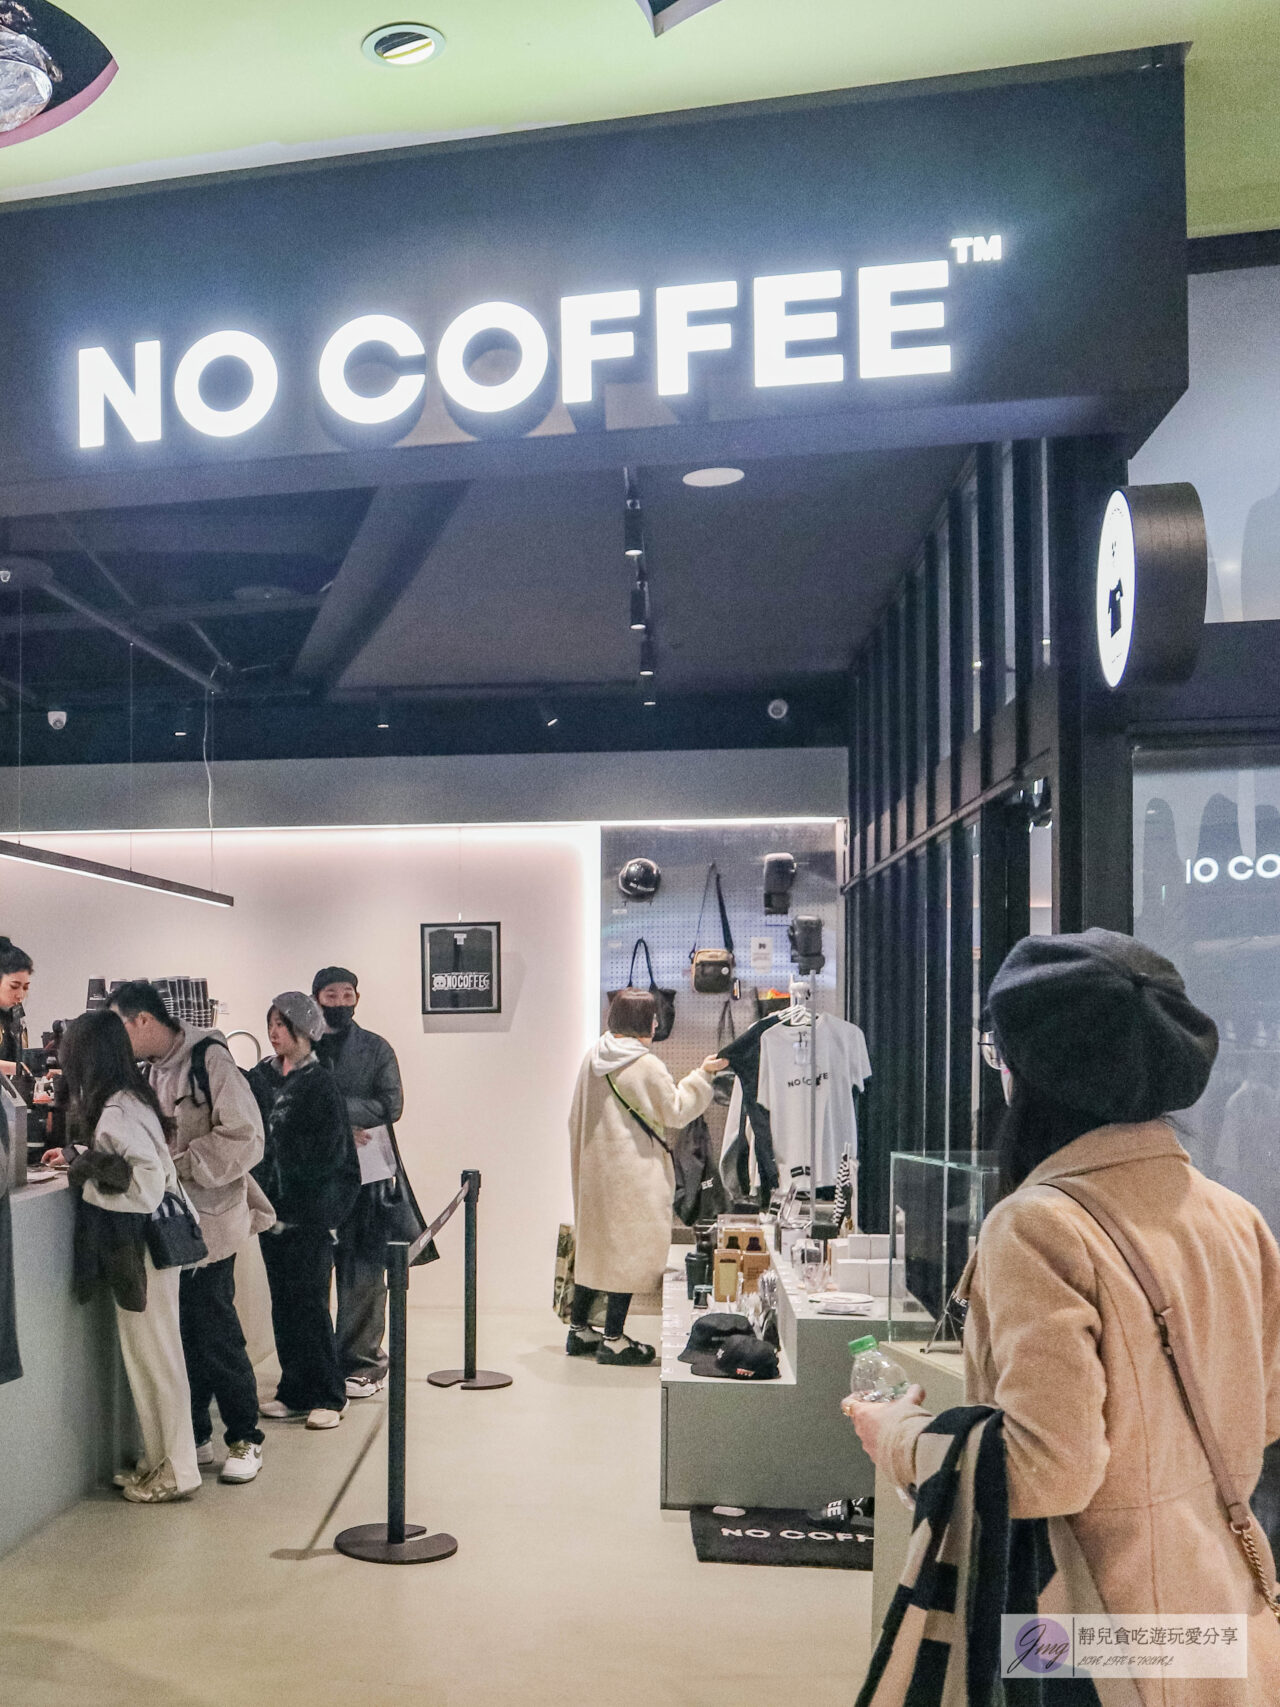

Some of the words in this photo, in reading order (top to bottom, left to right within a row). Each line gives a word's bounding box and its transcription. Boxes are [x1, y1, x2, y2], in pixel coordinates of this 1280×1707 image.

[78, 328, 279, 449] NO
[319, 259, 953, 425] COFFEE
[720, 1527, 771, 1539] NO
